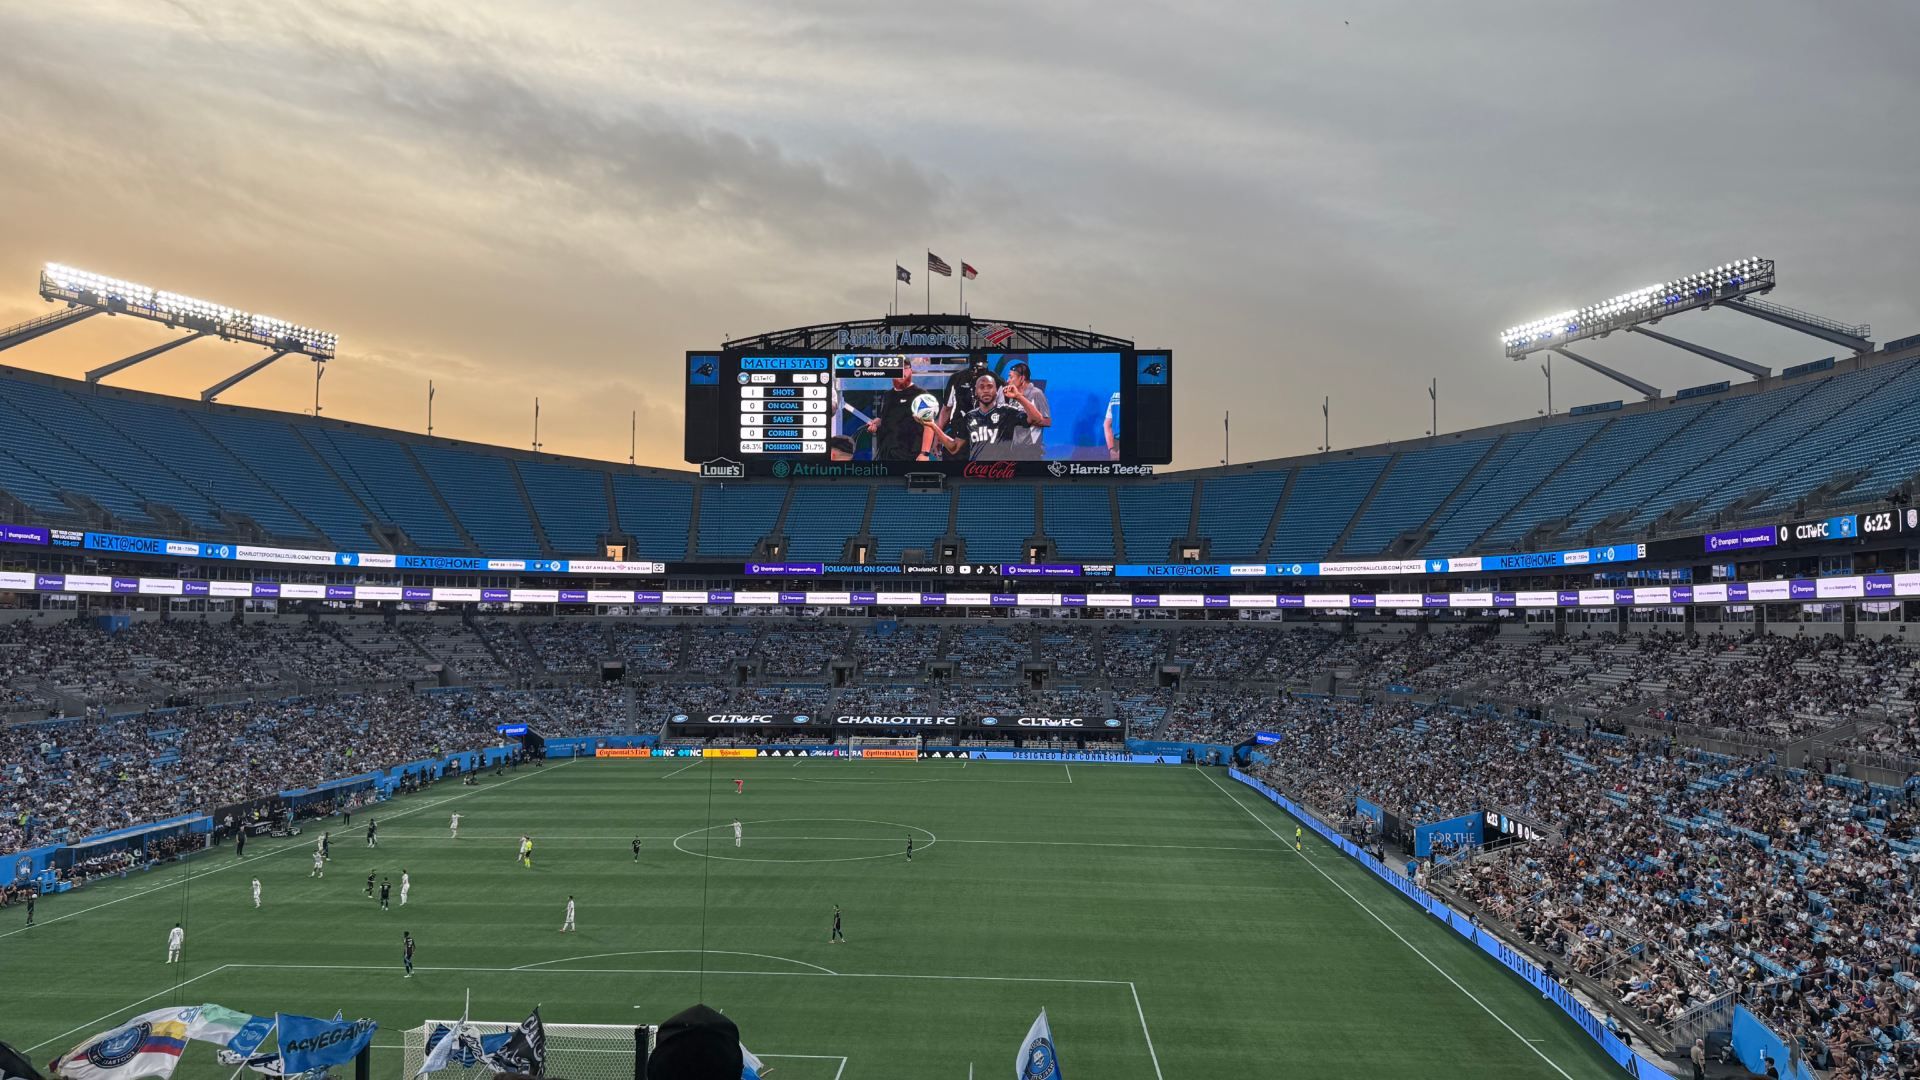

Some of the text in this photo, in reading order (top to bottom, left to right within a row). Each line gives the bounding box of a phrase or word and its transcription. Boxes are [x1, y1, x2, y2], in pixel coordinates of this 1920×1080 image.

[838, 330, 969, 346] Bank of America
[744, 359, 825, 369] MATCH STATS
[878, 357, 899, 367] 6:23
[970, 426, 999, 444] ally
[793, 463, 888, 476] Atrium Health
[1070, 463, 1153, 475] Harris Teeter
[1863, 513, 1891, 532] 6:23
[1780, 526, 1788, 541] 0
[92, 535, 159, 552] NEXT@HOME
[405, 557, 480, 569] NEXT@HOME
[1500, 553, 1557, 568] NEXT@HOME
[825, 565, 901, 573] FOLLOW US ON SOCIAL
[1147, 566, 1219, 575] NEXT@HOME
[837, 715, 956, 725] CHARLOTTE FC
[1013, 752, 1133, 762] DESIGNED FOR CONNECTION
[1428, 832, 1475, 843] FOR THE
[1498, 942, 1605, 1045] DESIGNED FOR CONNECTION
